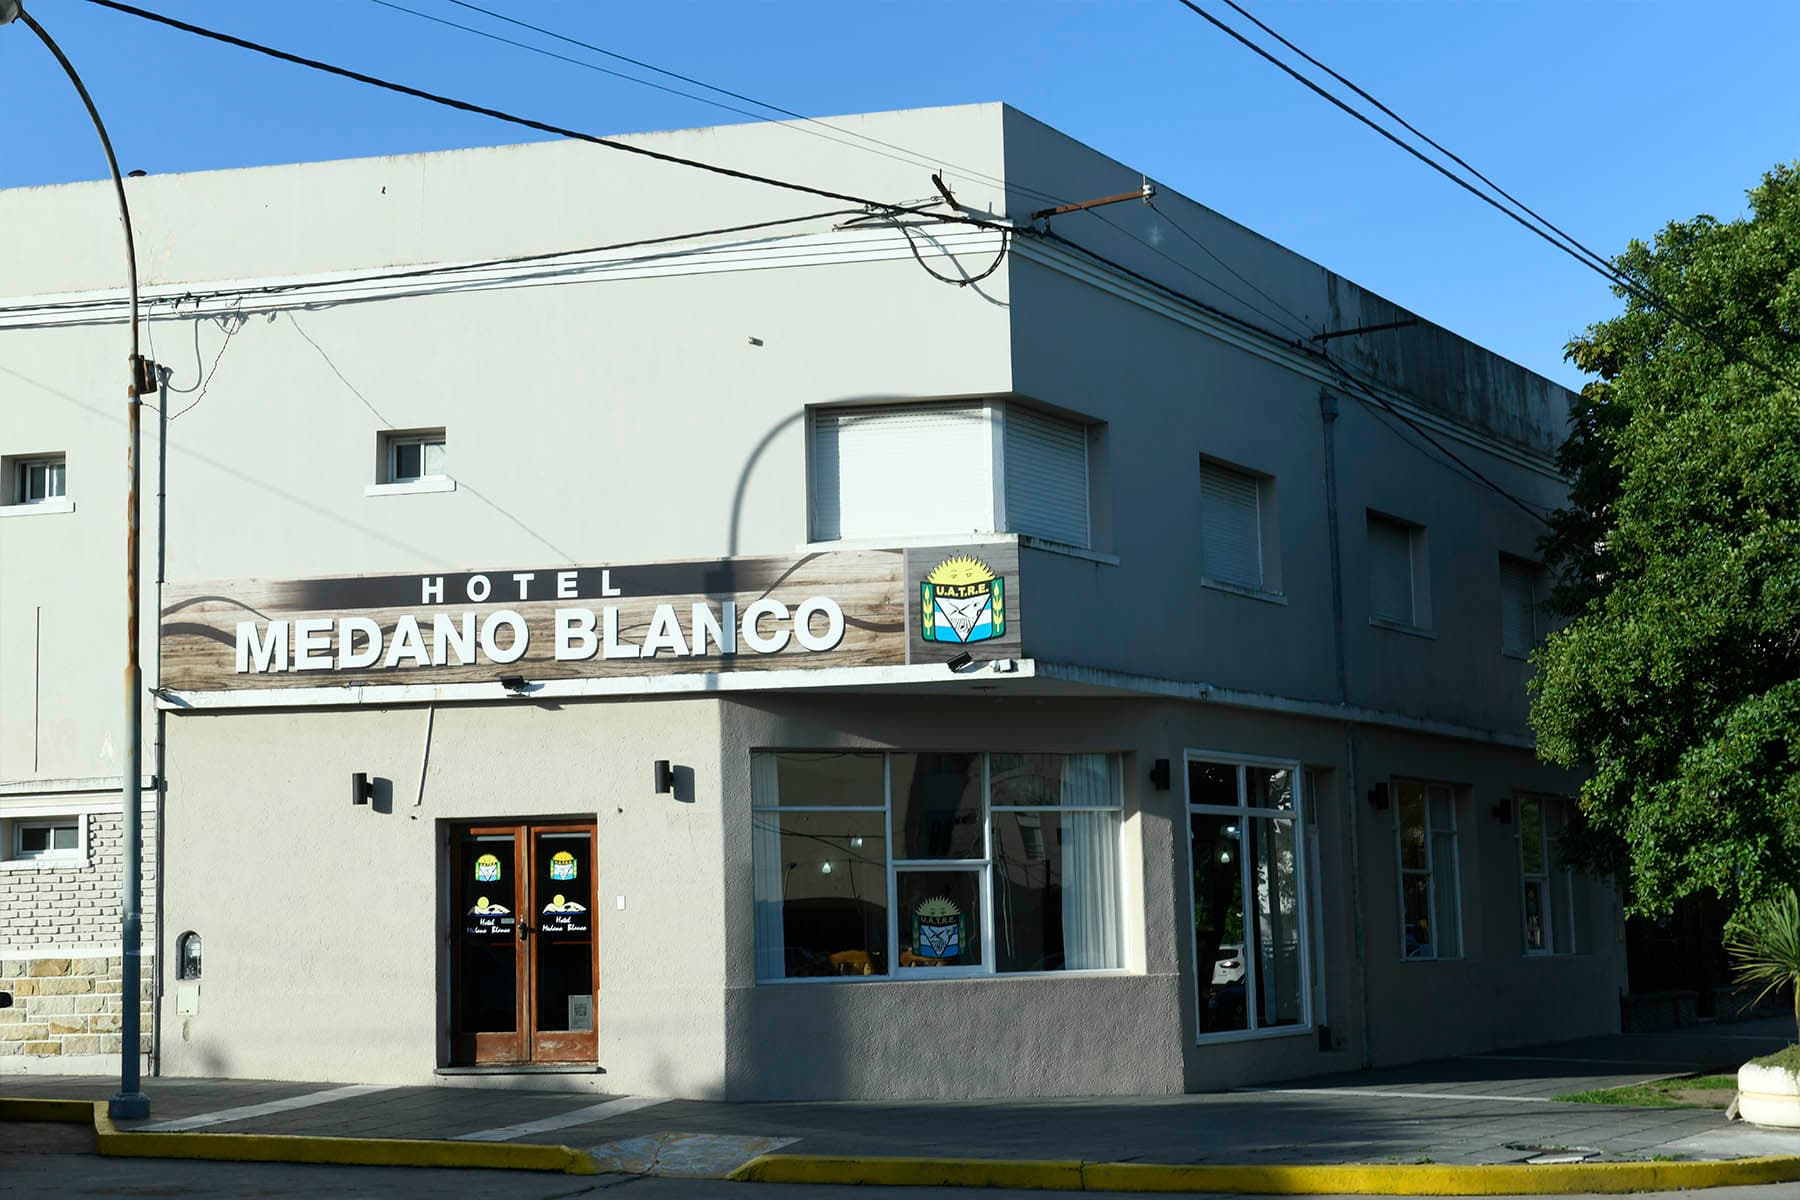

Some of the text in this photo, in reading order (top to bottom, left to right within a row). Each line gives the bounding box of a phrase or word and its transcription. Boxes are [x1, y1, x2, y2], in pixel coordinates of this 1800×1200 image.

[421, 569, 621, 604] HOTEL
[935, 583, 990, 598] U.A.T.R.E.
[235, 596, 846, 673] MEDANO BLANCO
